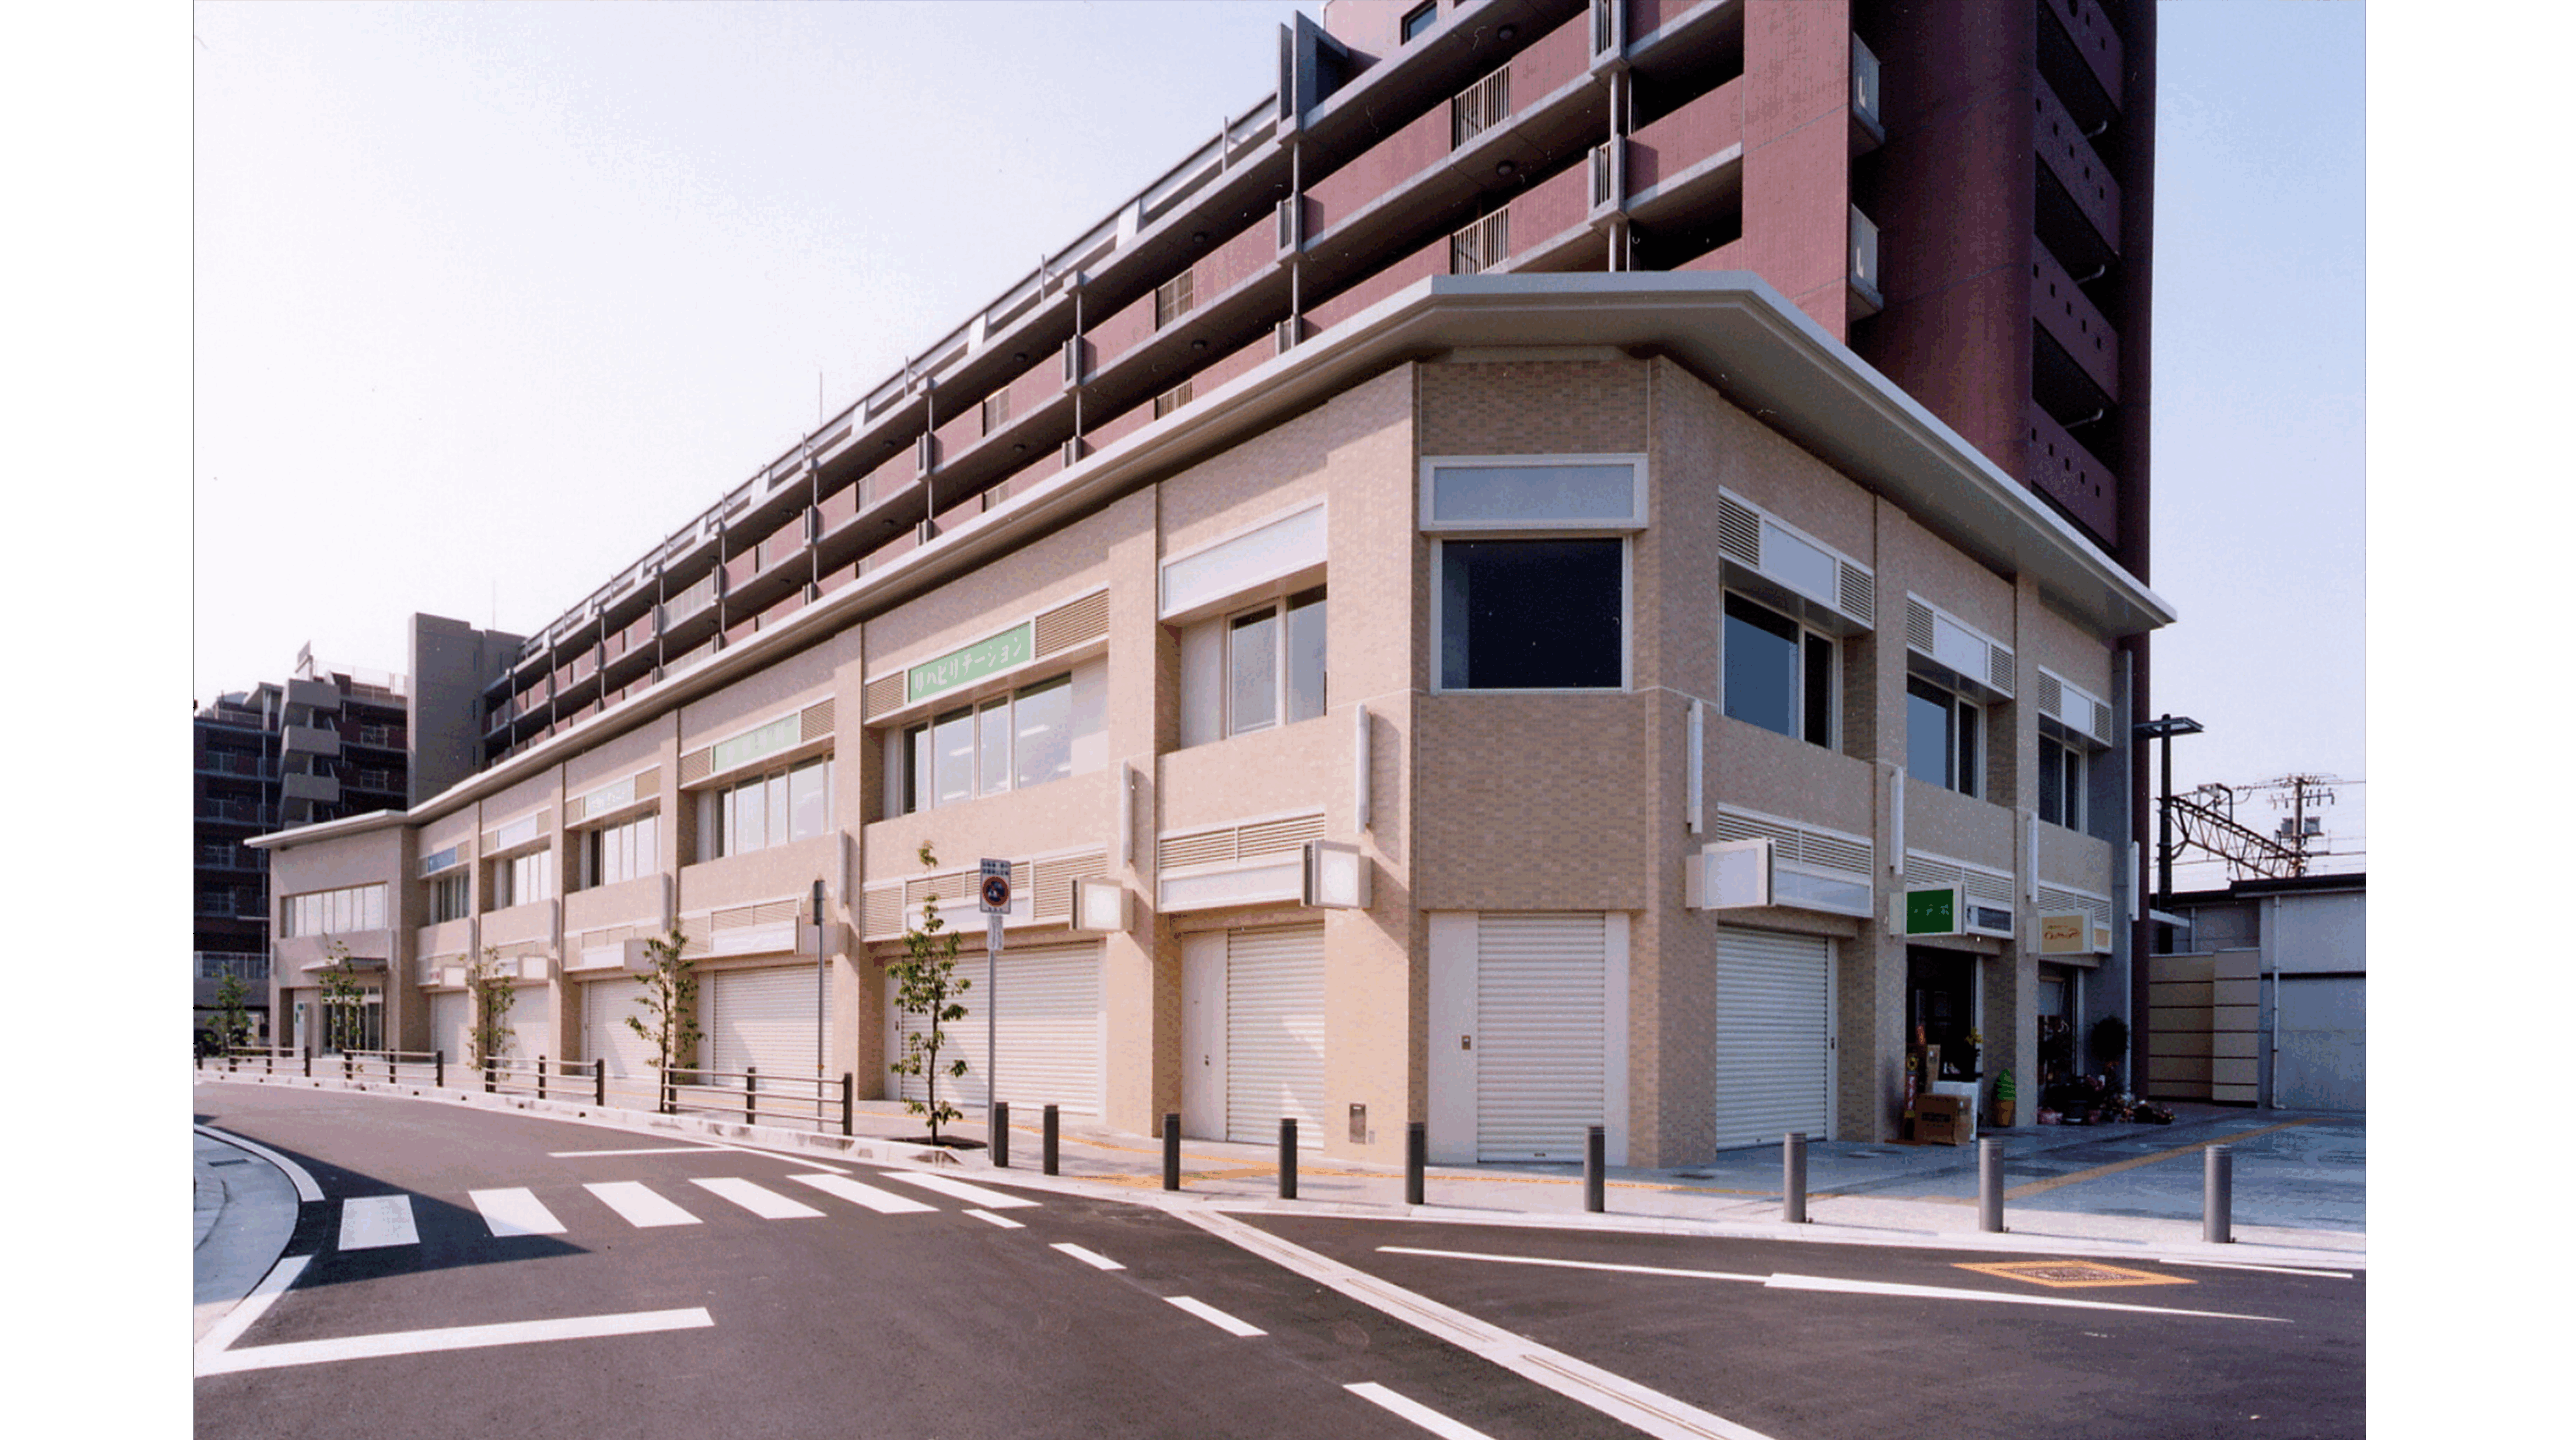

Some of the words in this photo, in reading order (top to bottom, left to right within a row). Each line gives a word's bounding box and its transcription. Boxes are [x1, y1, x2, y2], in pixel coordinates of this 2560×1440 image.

[914, 636, 1022, 693] リハビリテーション
